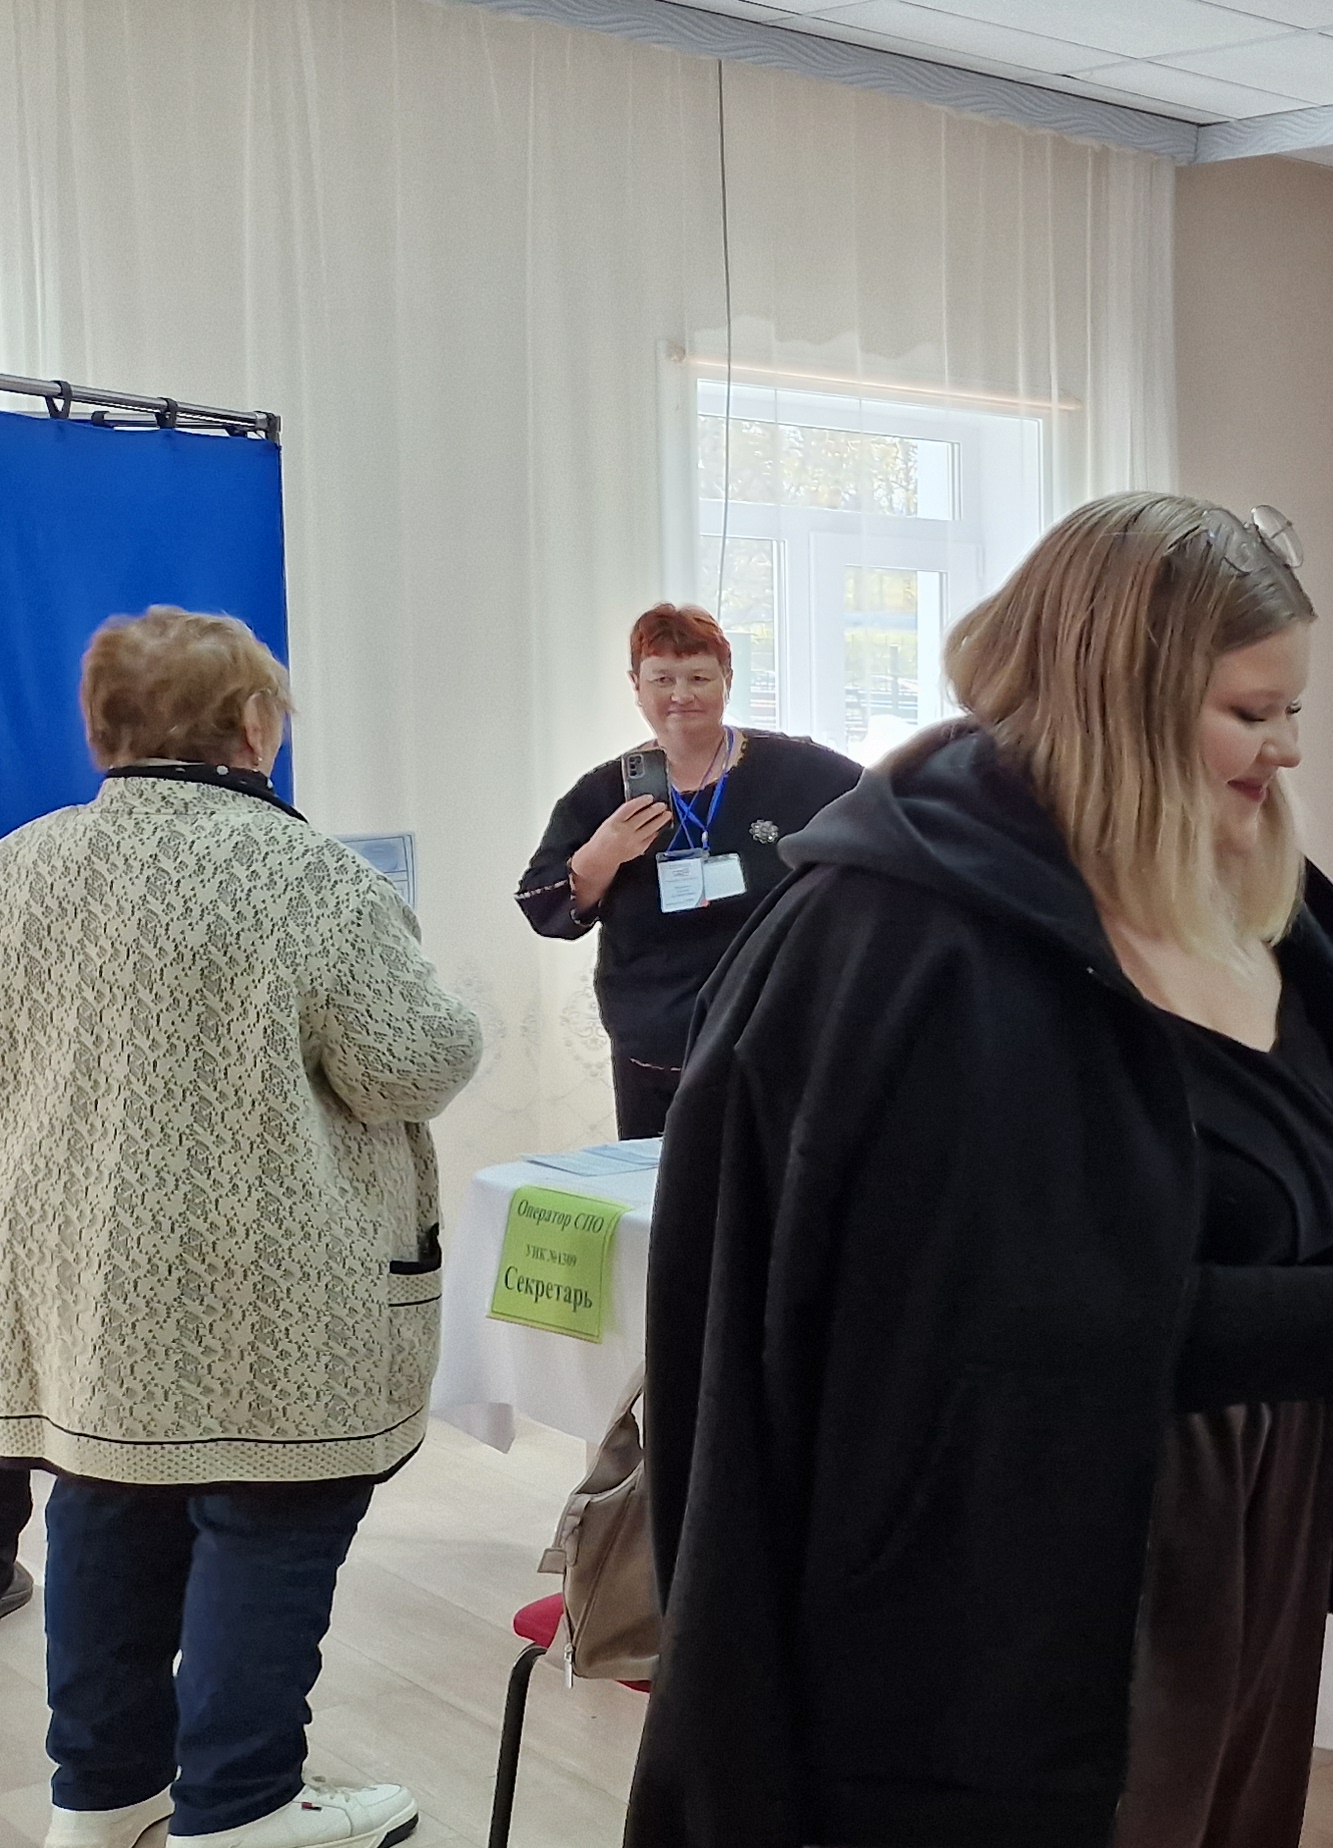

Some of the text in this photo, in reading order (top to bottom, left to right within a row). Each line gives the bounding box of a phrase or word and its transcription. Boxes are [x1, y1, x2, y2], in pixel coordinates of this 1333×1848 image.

[517, 1199, 605, 1234] Оператор СПО
[504, 1265, 593, 1313] Секретарь
